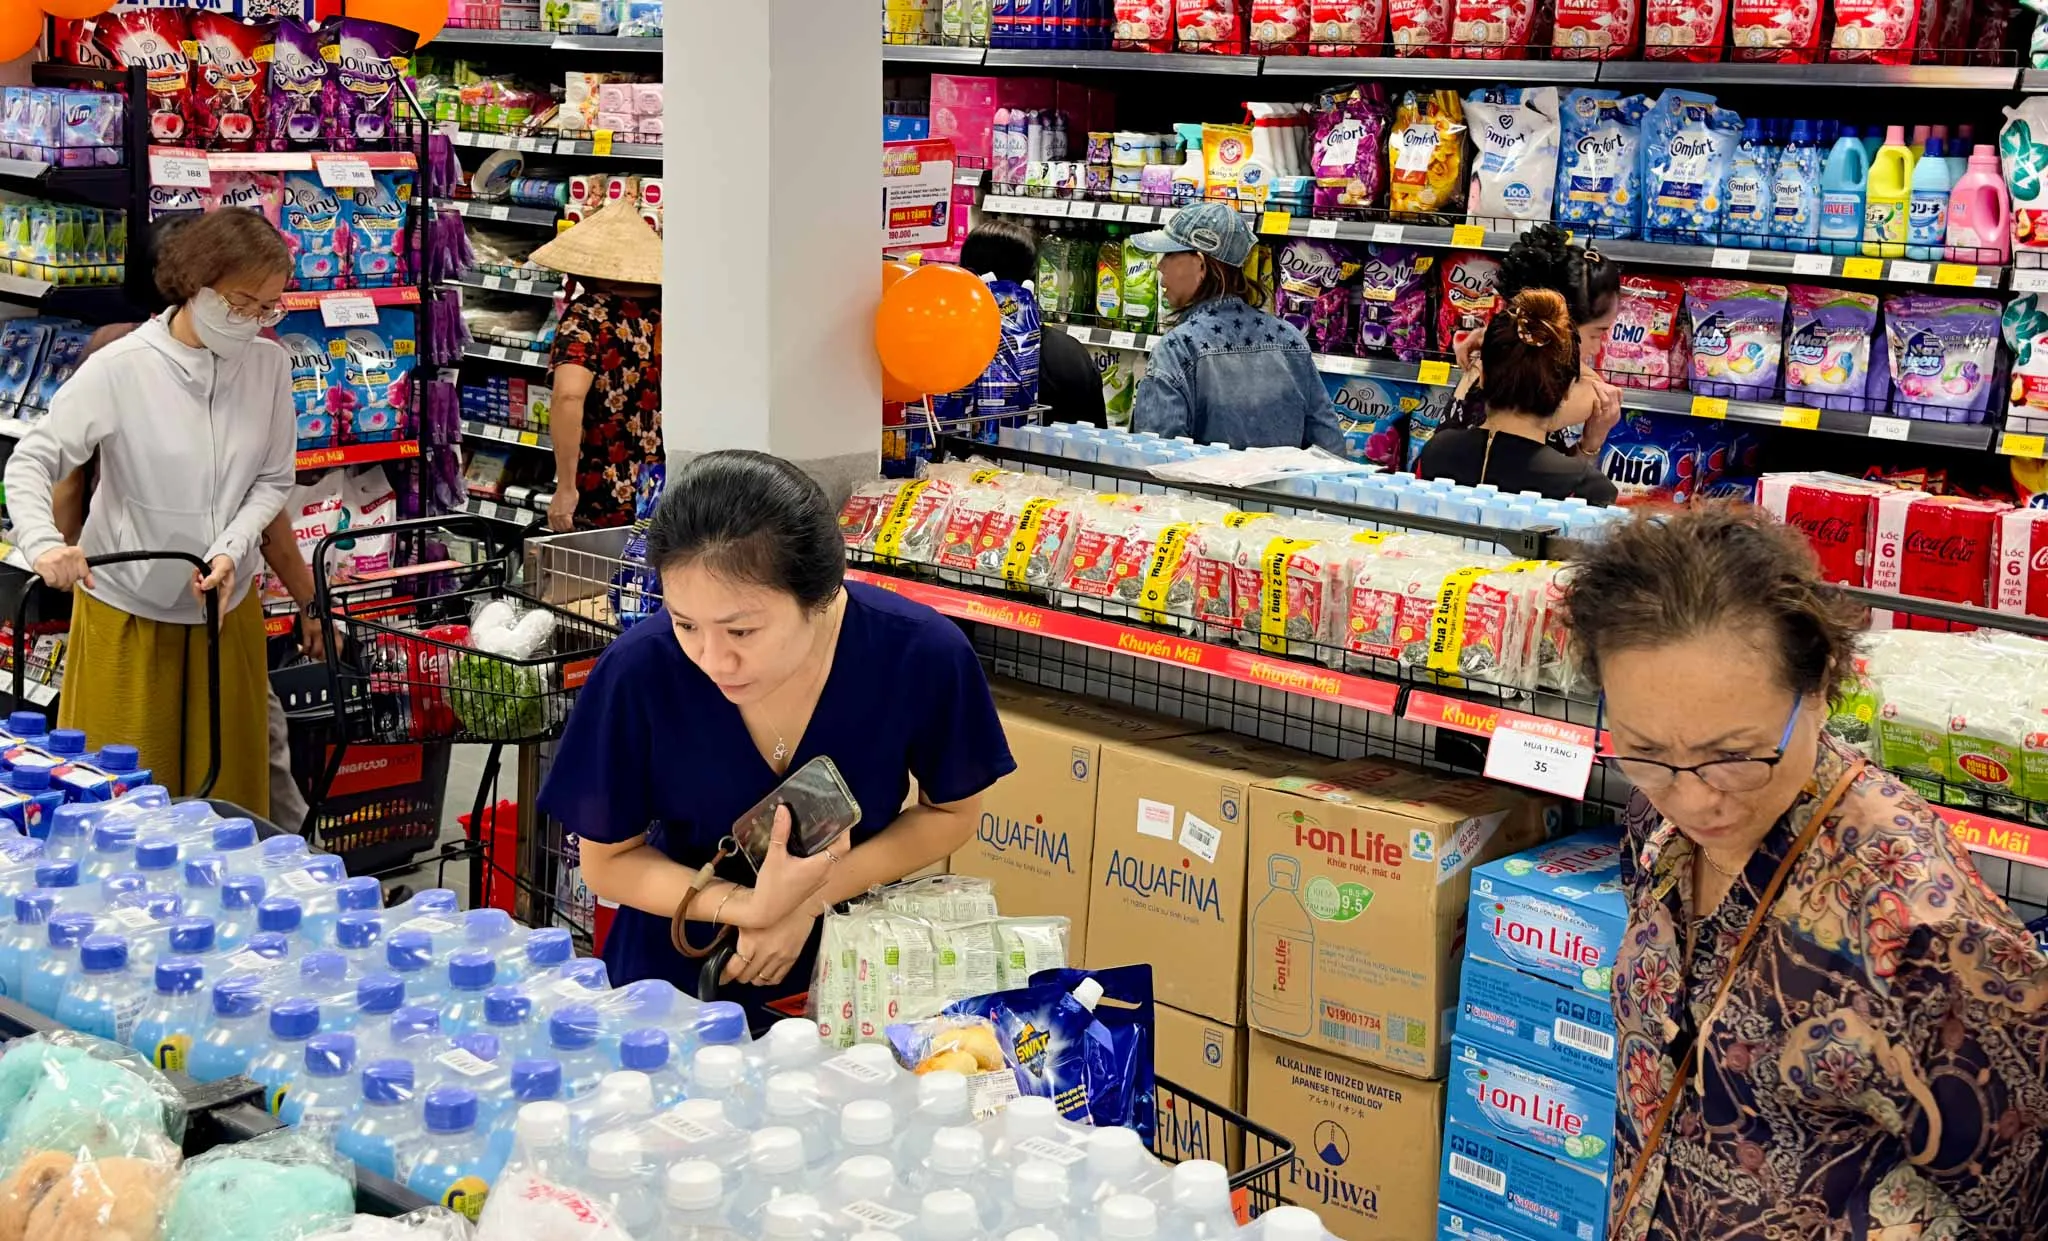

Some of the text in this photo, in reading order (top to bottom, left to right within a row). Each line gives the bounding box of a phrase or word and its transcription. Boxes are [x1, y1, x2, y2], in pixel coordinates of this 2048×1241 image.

[67, 105, 90, 124] Vim
[1670, 136, 1715, 158] Comfort
[1727, 180, 1760, 192] Comfort
[1775, 182, 1803, 194] Comfort
[1280, 248, 1339, 287] Downy
[1613, 322, 1645, 344] OMO
[1882, 542, 1896, 558] 6
[1880, 558, 1896, 569] GIÁ
[2007, 560, 2021, 576] 6
[1873, 578, 1897, 590] KIỆM
[2004, 577, 2020, 587] GIÁ
[966, 600, 1042, 629] Khuyến Mãi
[1436, 617, 1448, 625] 2
[1118, 632, 1202, 665] Khuyến Mãi
[1434, 628, 1445, 653] Mua
[1250, 661, 1341, 694] Khuyến Mãi
[1442, 704, 1496, 733] Khuyế
[1512, 718, 1581, 743] KHUYẾN MÃI
[1523, 740, 1541, 751] MUA
[1533, 759, 1548, 773] 35
[1351, 827, 1403, 867] Life
[1988, 827, 2031, 855] Mãi
[1440, 849, 1463, 872] SGS
[1106, 848, 1222, 921] AQUAFINA
[1342, 896, 1363, 912] 9.5
[1277, 938, 1288, 965] Life
[1550, 926, 1600, 967] Life
[1015, 1033, 1050, 1063] SWAT
[1552, 1043, 1562, 1053] 24
[1563, 1047, 1582, 1059] Chai
[1275, 1055, 1402, 1104] ALKALINE IONIZED WATER
[1292, 1076, 1383, 1111] JAPANESE TECHNOLOGY
[1533, 1094, 1583, 1136] Life
[1289, 1157, 1378, 1213] Fujiwa
